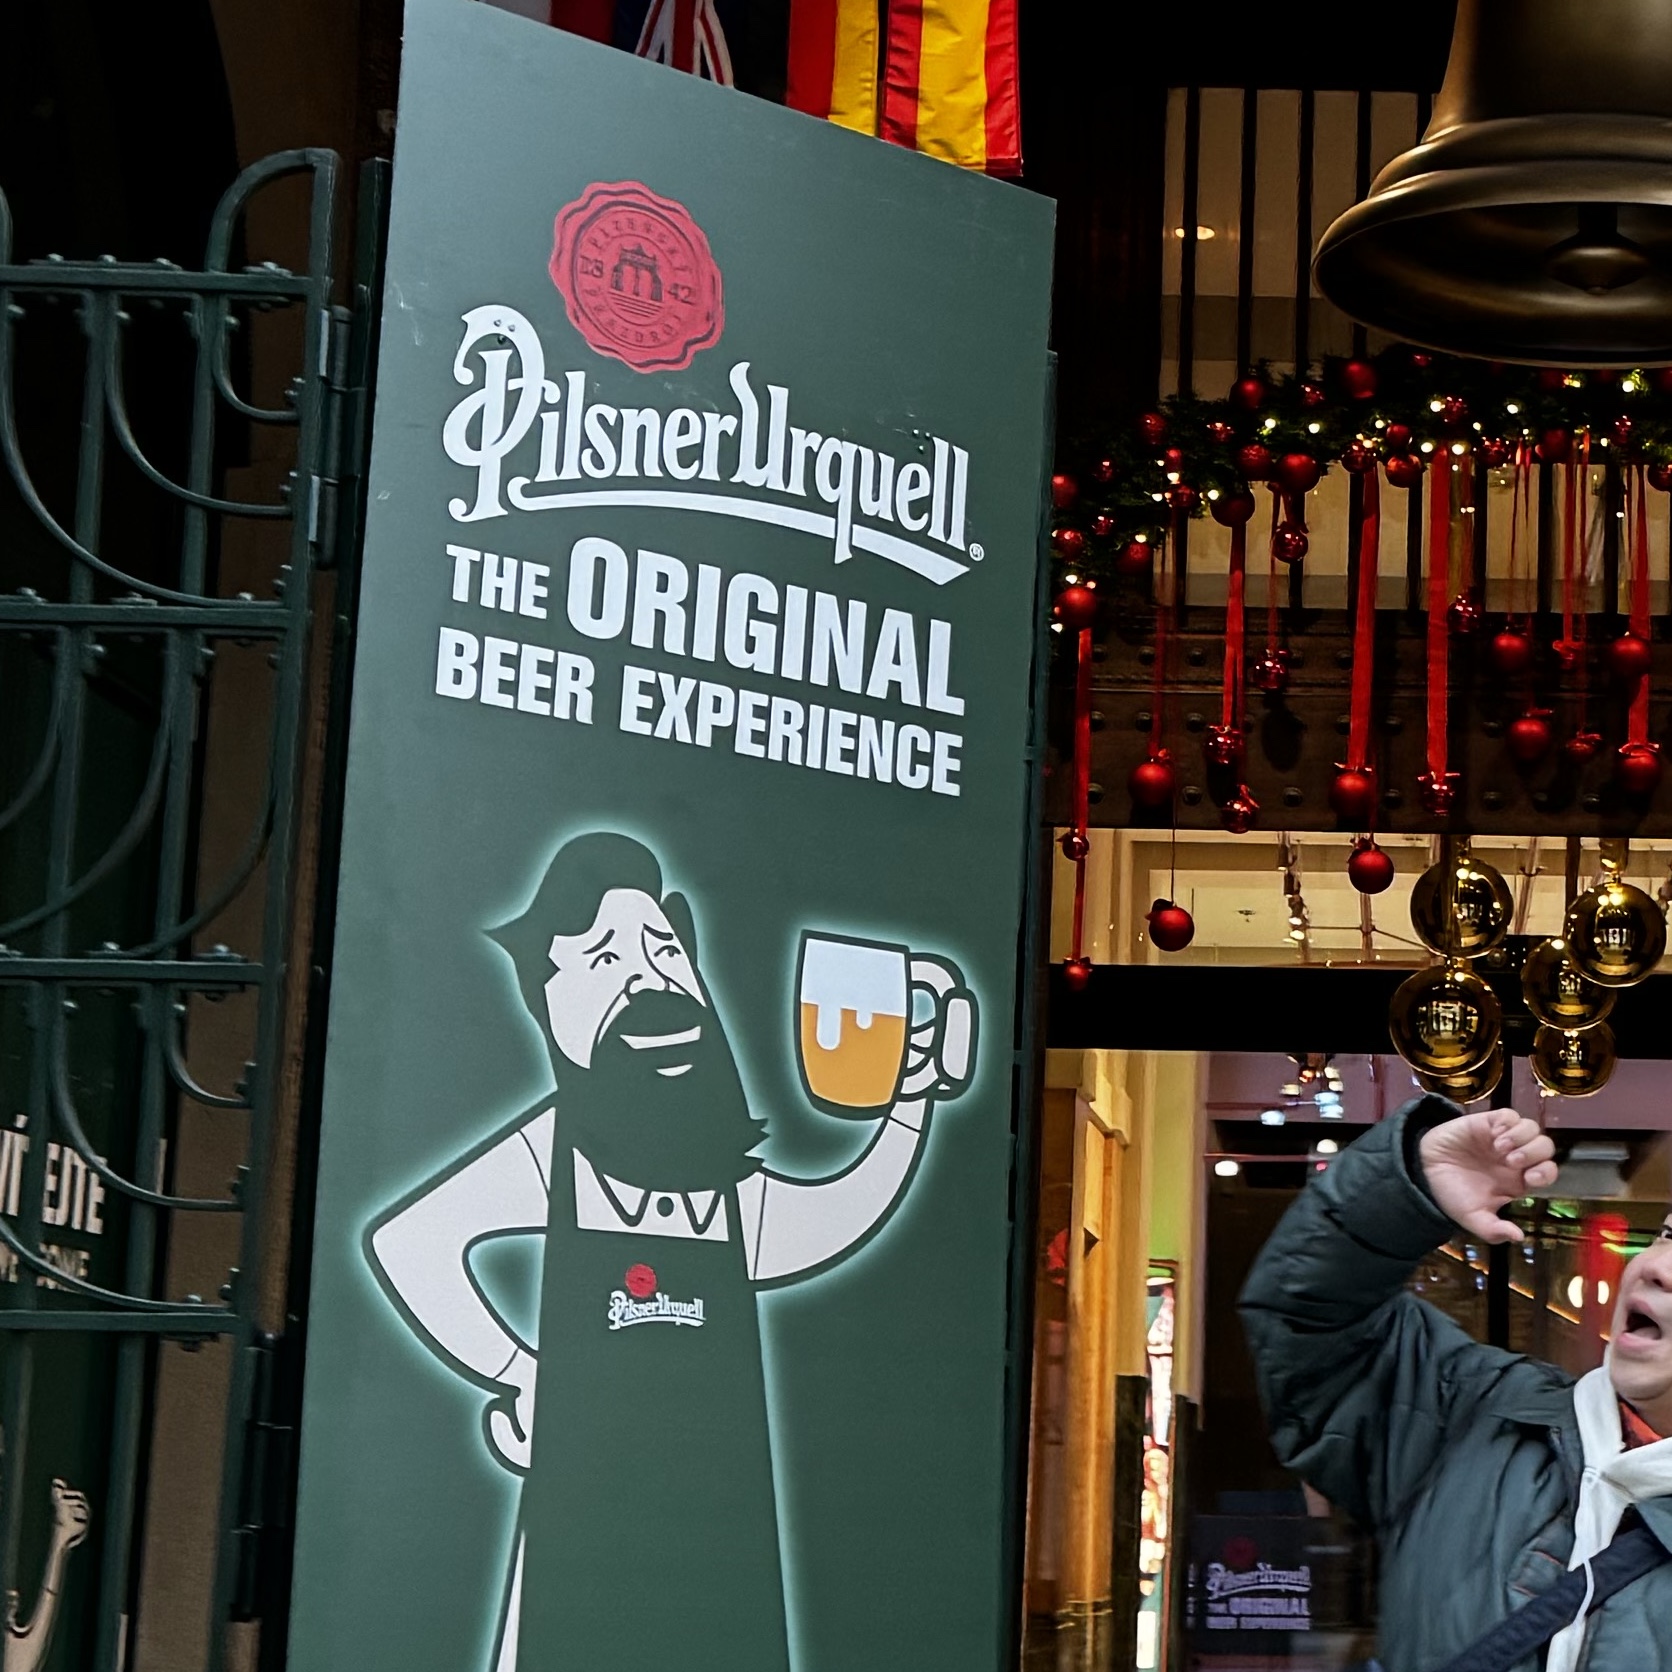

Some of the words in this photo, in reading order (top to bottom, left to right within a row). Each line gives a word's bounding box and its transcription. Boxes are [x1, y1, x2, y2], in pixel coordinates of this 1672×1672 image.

[443, 305, 737, 522] Pilsner
[730, 362, 970, 564] Urquell
[436, 627, 595, 726] BEER
[620, 665, 964, 798] EXPERIENCE
[446, 544, 551, 620] THE
[567, 538, 966, 718] ORIGINAL
